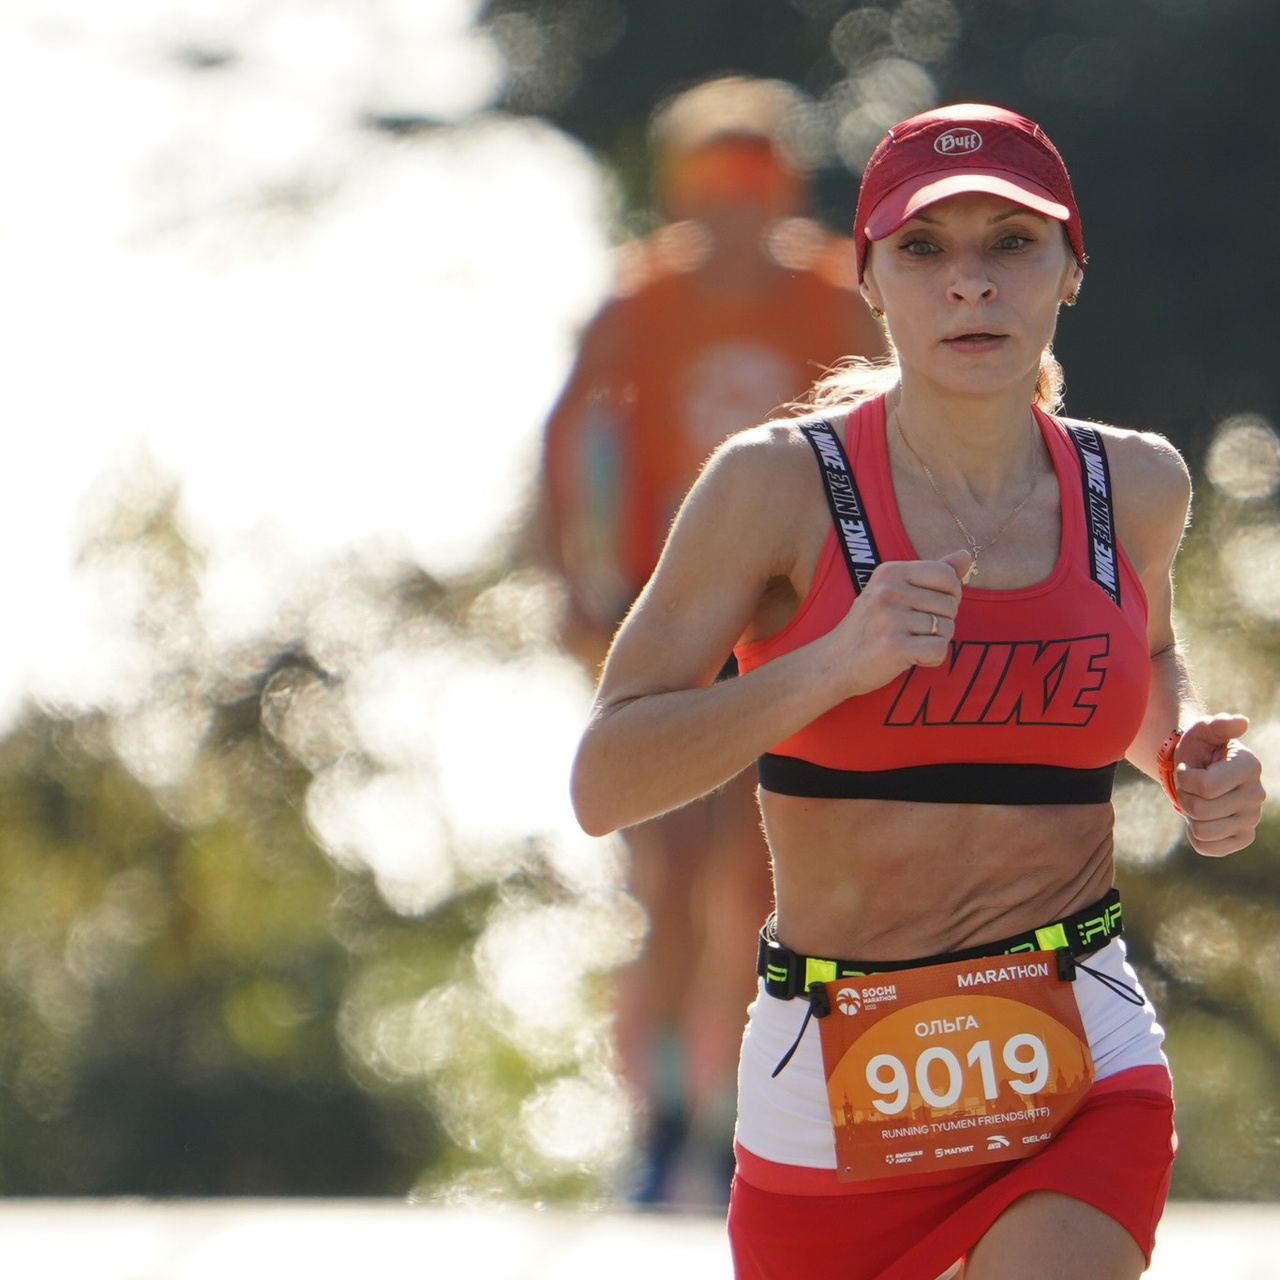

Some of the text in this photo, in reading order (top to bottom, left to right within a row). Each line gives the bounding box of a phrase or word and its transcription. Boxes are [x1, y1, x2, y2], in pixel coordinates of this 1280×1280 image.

[809, 430, 846, 470] NIKE
[826, 470, 861, 516] NIKE
[1081, 448, 1111, 544] NIKE NIKE
[840, 518, 876, 565] NIKE
[1094, 538, 1117, 592] NIKE
[883, 633, 1110, 727] NIKE
[862, 985, 896, 998] SOCHI
[957, 963, 1049, 988] MARATHON
[863, 994, 897, 1004] MARATHON
[914, 1015, 979, 1037] ОЛЬГА
[865, 1033, 1049, 1115] 9019
[881, 1107, 1050, 1139] RUNNING TYUMEN FRIENDS(RTF)
[944, 1145, 974, 1155] МАГНИТ
